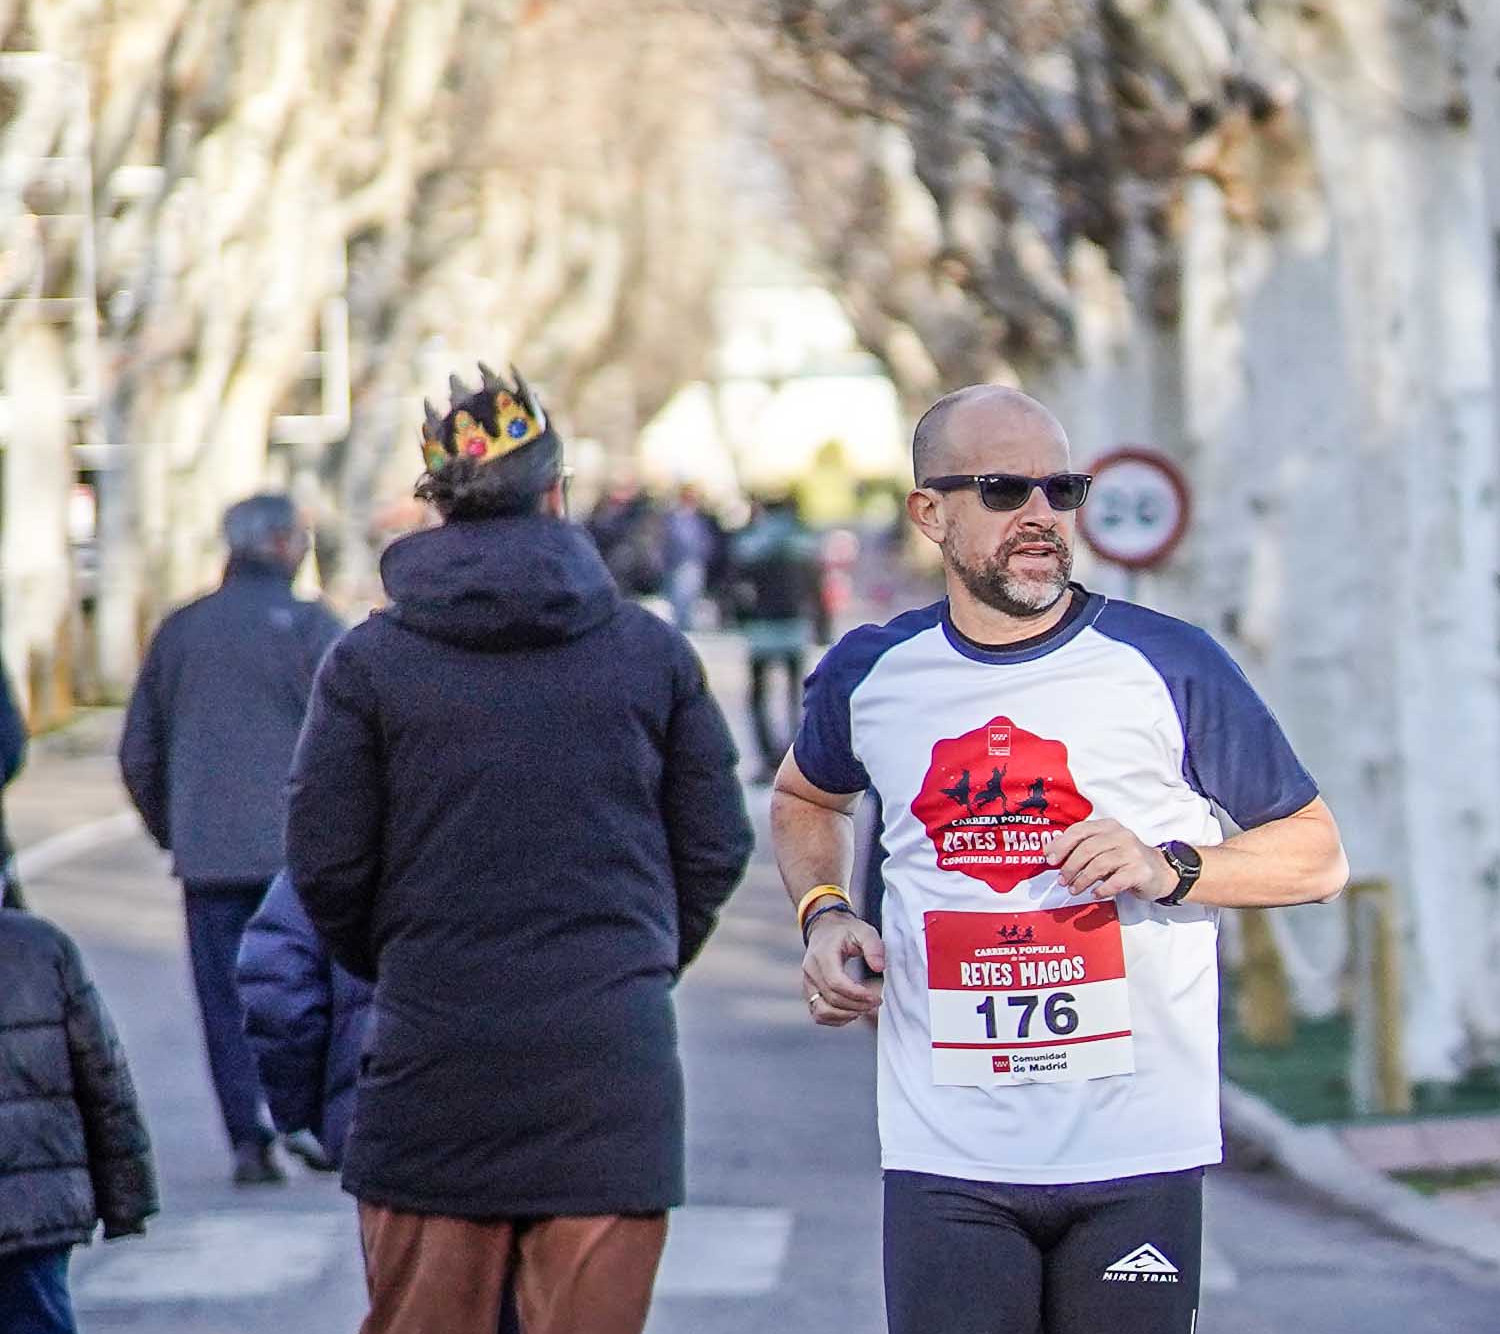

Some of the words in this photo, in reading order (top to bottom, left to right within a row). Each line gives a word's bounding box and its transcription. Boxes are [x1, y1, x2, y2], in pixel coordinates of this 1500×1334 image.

[952, 816, 998, 827] CARRERA
[1001, 816, 1050, 825] POPULAR
[942, 831, 996, 853] REYES
[942, 855, 1001, 866] COMUNIDAD
[1006, 855, 1019, 864] DE
[975, 947, 1017, 957] CARRERA
[1019, 946, 1066, 954] POPULAR
[960, 962, 1013, 987] REYES
[1020, 956, 1085, 986] MAGOS
[976, 992, 1080, 1039] 176
[1012, 1051, 1067, 1062] Comunidad
[1013, 1065, 1026, 1073] de
[1029, 1062, 1067, 1072] Madrid
[1102, 1272, 1138, 1282] NIKE
[1142, 1273, 1179, 1283] TRAIL
